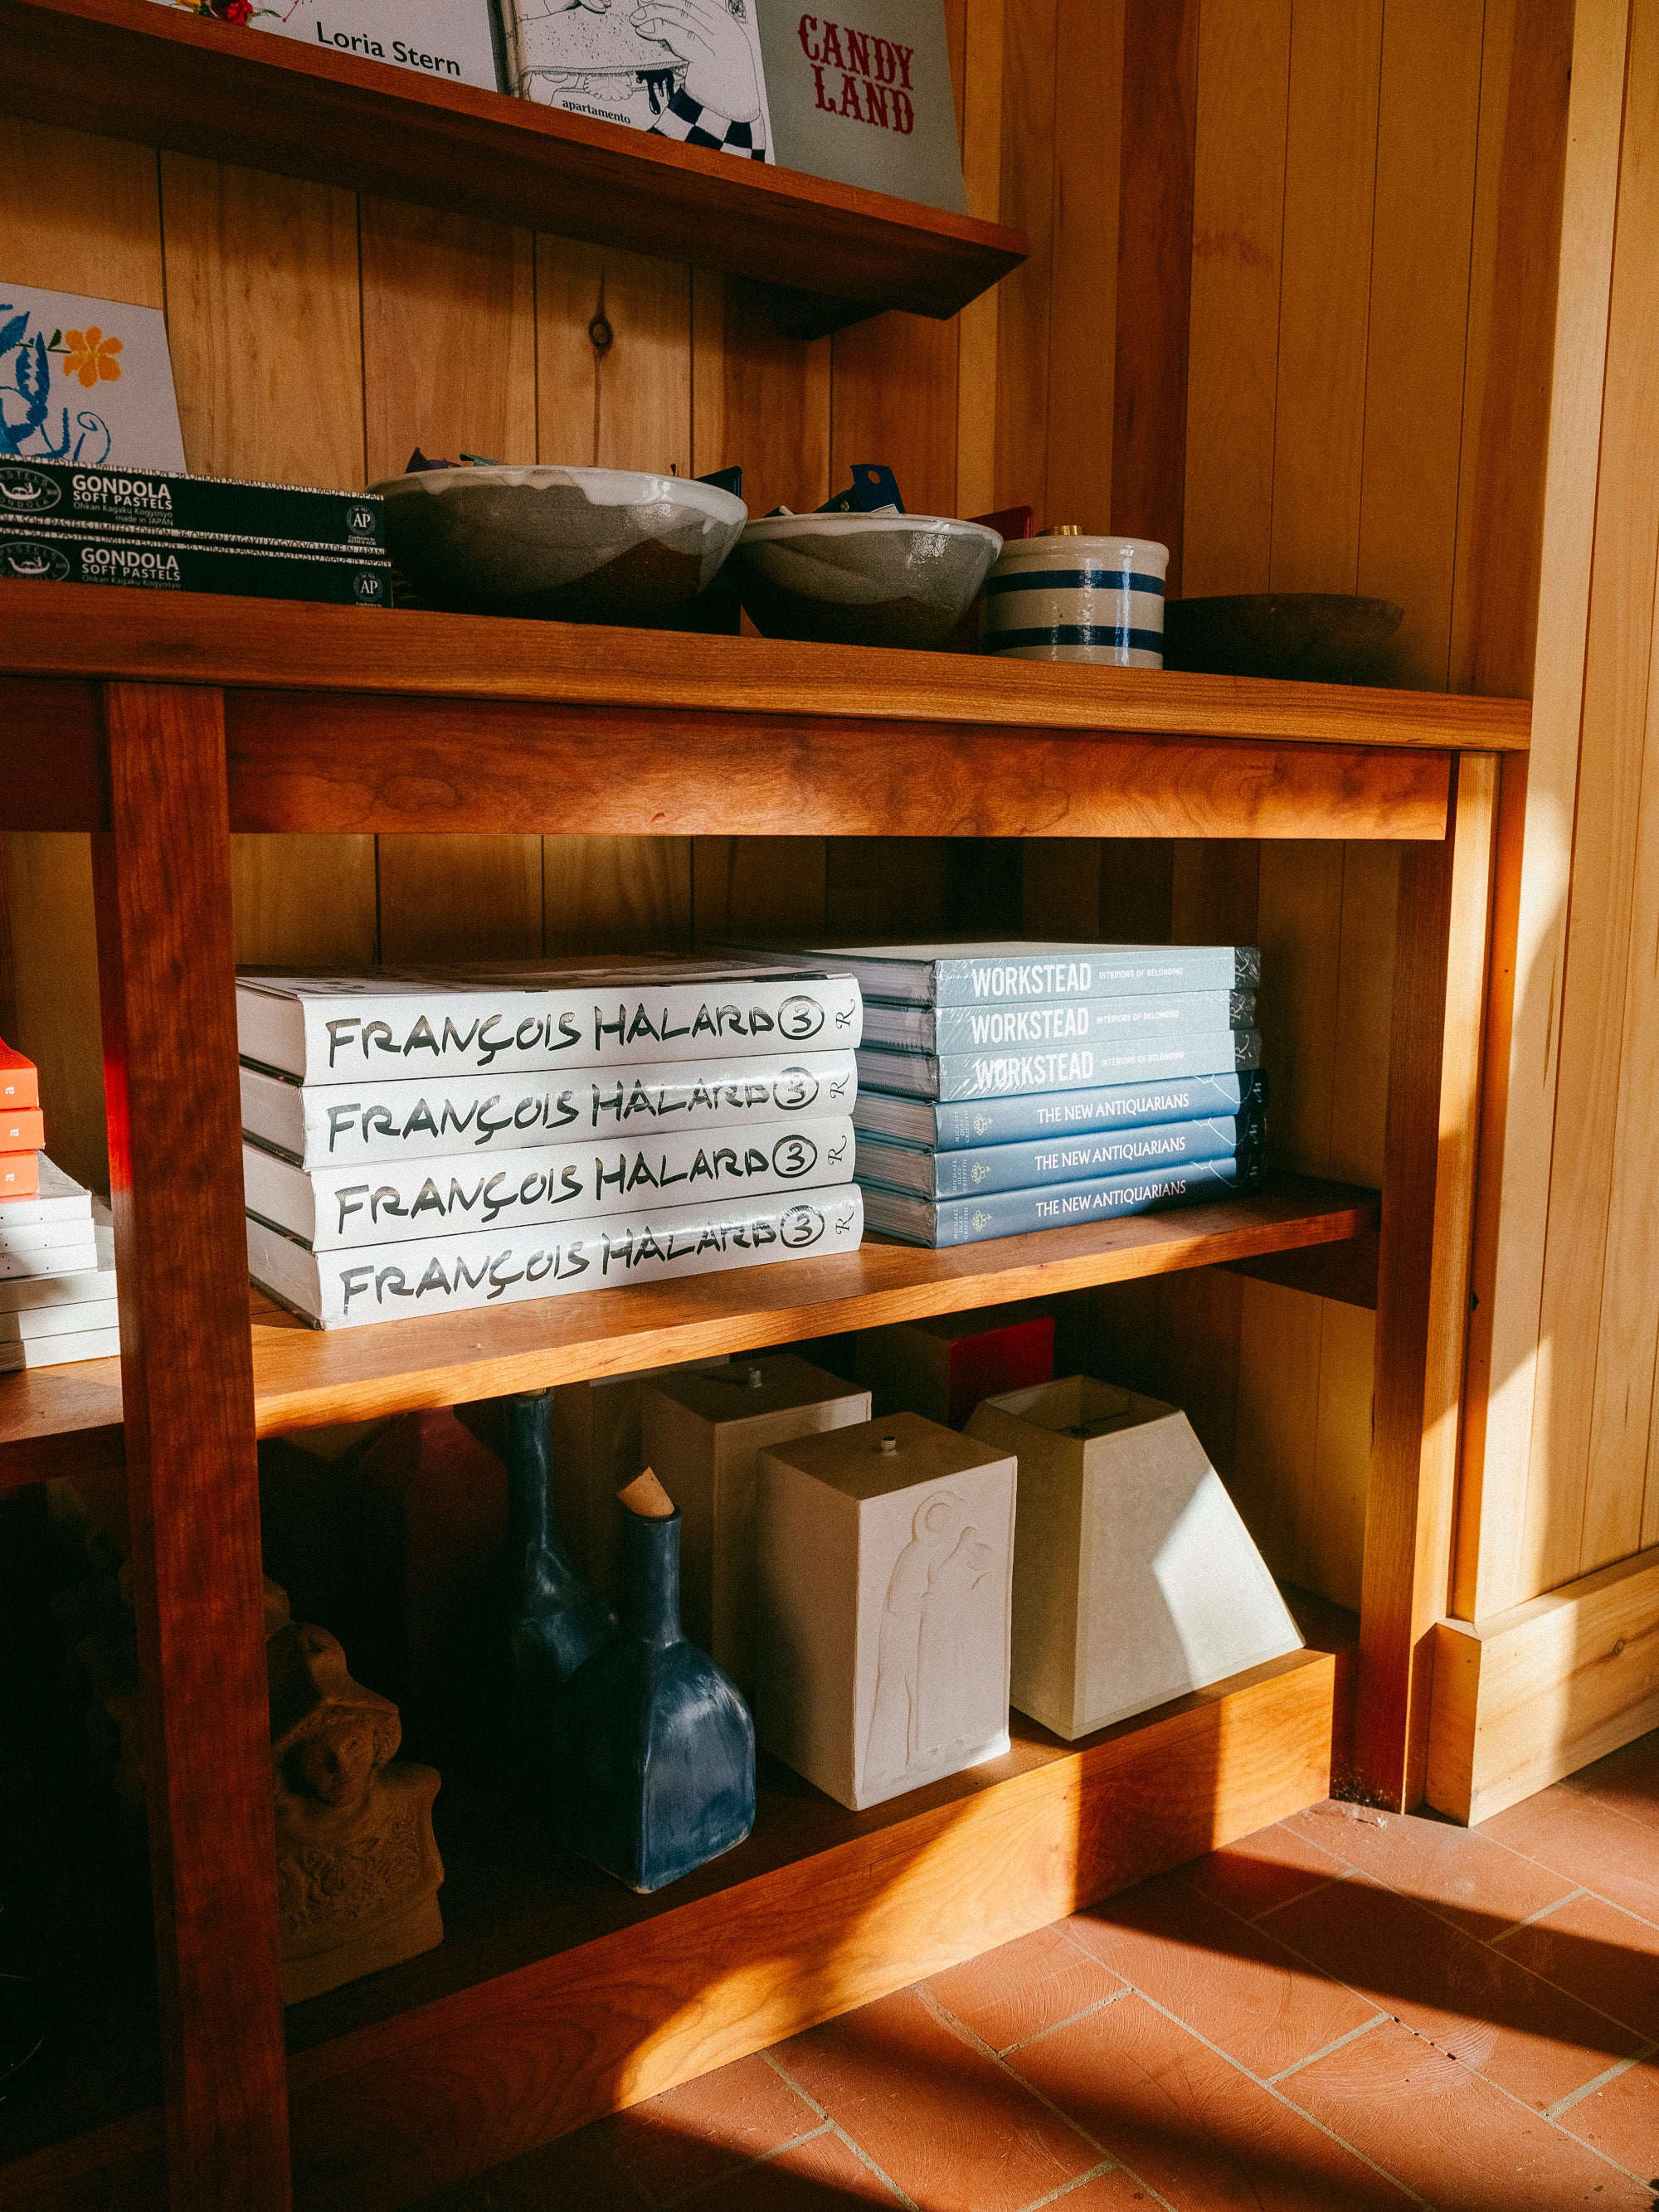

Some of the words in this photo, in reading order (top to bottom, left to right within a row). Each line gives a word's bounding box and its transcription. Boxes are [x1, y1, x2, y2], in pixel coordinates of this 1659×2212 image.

[316, 21, 385, 58] Loria
[392, 41, 460, 76] Stern
[797, 13, 914, 91] CANDY
[562, 99, 631, 124] apartamento
[810, 63, 914, 135] LAND
[72, 474, 172, 499] GONDOLA
[72, 490, 109, 504] SOFT
[114, 495, 173, 510] PASTELS
[73, 501, 100, 511] Ohkan
[102, 503, 133, 514] Kagaku
[134, 507, 173, 518] Kogyosyo
[115, 514, 137, 523] made
[148, 516, 173, 526] JAPAN
[353, 513, 372, 527] AP
[81, 547, 179, 571] GONDOLA
[81, 563, 117, 576] SOFT
[123, 566, 181, 581] PASTELS
[360, 579, 378, 595] AP
[971, 962, 1092, 997] WORKSTEAD
[1098, 970, 1135, 980] INTERIORS
[1136, 969, 1145, 978] OF
[1146, 967, 1184, 977] BELONGING
[325, 1012, 581, 1068] FRANÇOIS
[594, 1002, 775, 1051] HALARD
[971, 1007, 1089, 1044] WORKSTEAD
[1096, 1014, 1131, 1024] INTERIORS
[1132, 1013, 1142, 1022] OF
[1143, 1009, 1180, 1020] BELONGING
[975, 1050, 1094, 1090] WORKSTEAD
[1101, 1057, 1136, 1067] INTERIORS
[1136, 1054, 1146, 1063] OF
[325, 1090, 580, 1153] FRANÇOIS
[591, 1078, 770, 1127] HALARD
[1037, 1106, 1062, 1124] THE
[1063, 1103, 1094, 1121] NEW
[1095, 1093, 1190, 1117] ANTIQUARIANS
[1034, 1153, 1059, 1170] THE
[1061, 1149, 1092, 1167] NEW
[1092, 1136, 1186, 1164] ANTIQUARIANS
[334, 1164, 584, 1234] FRANÇOIS
[595, 1148, 770, 1201] HALARD
[1035, 1200, 1059, 1217] THE
[1062, 1195, 1092, 1213] NEW
[1092, 1180, 1186, 1208] ANTIQUARIANS
[338, 1241, 590, 1315] FRANÇOIS
[601, 1219, 777, 1275] HALARD
